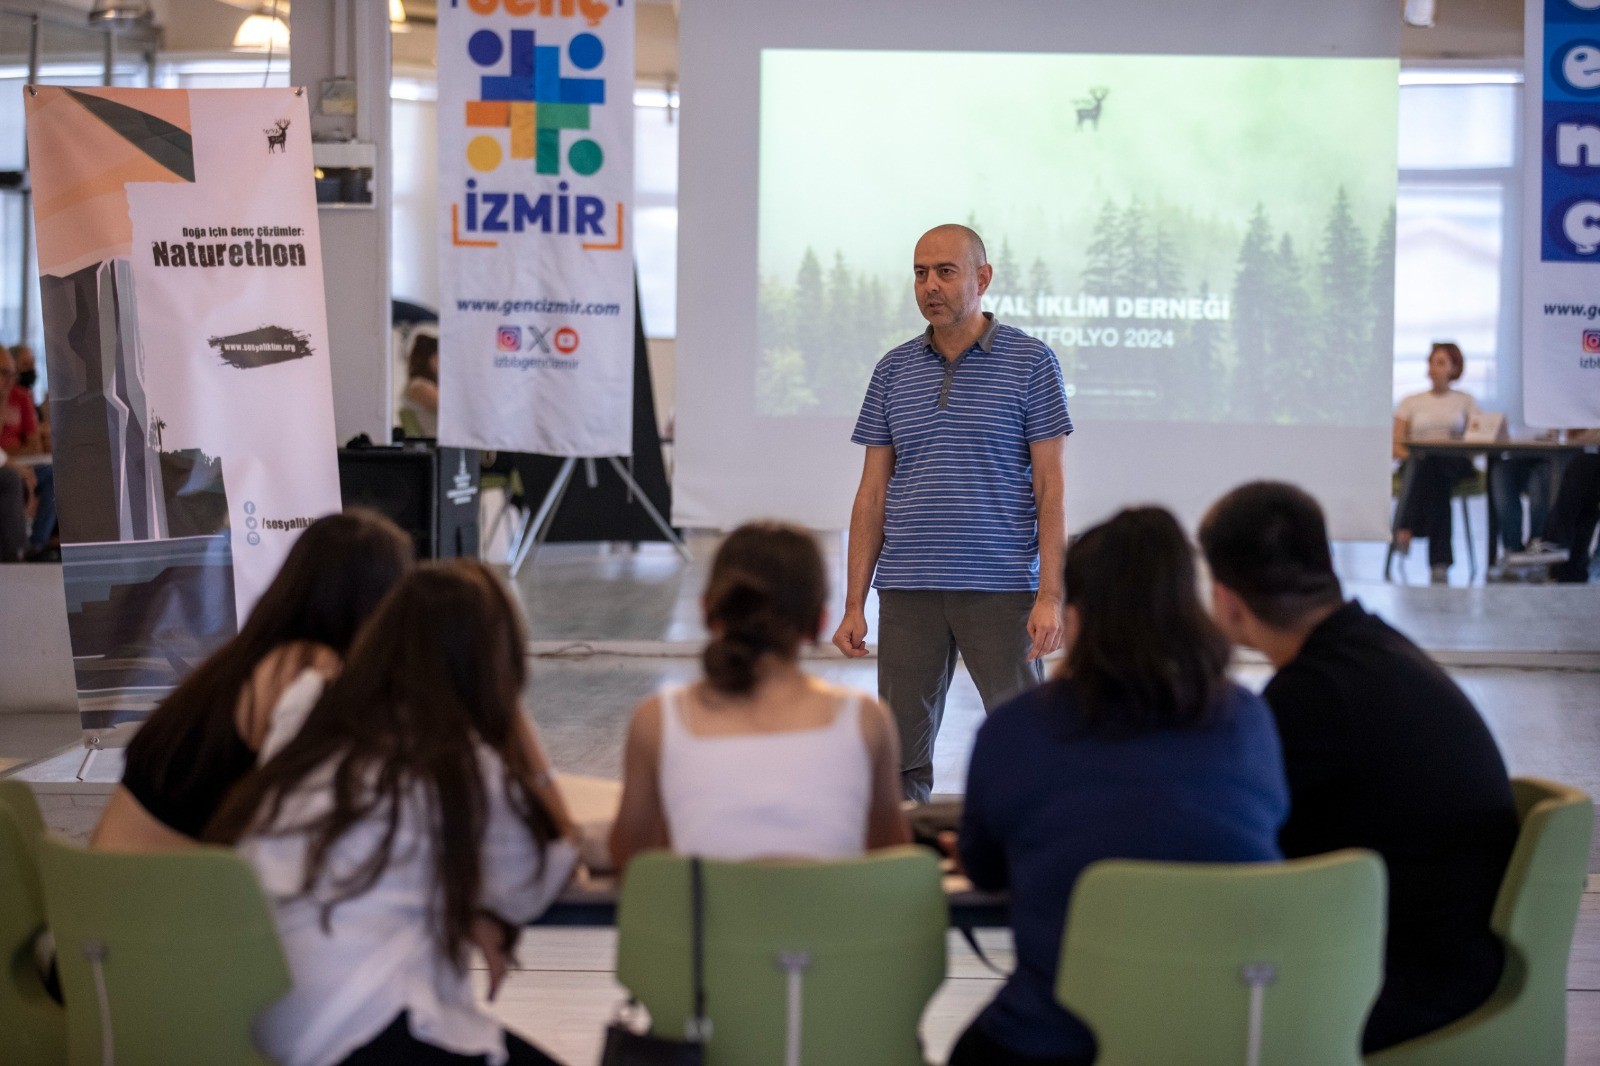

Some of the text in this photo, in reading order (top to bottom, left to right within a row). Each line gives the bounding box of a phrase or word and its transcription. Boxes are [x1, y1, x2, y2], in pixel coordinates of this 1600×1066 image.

[465, 178, 606, 236] İZMİR
[182, 227, 206, 239] Doğa
[231, 226, 254, 238] Genç
[151, 238, 307, 268] Naturethon
[456, 297, 620, 317] www.gencizmir.com
[1036, 289, 1109, 318] İKLİM
[1115, 292, 1231, 320] DERNEĞİ
[224, 343, 296, 353] www.sosyaliklim.org
[1124, 328, 1174, 348] 2024
